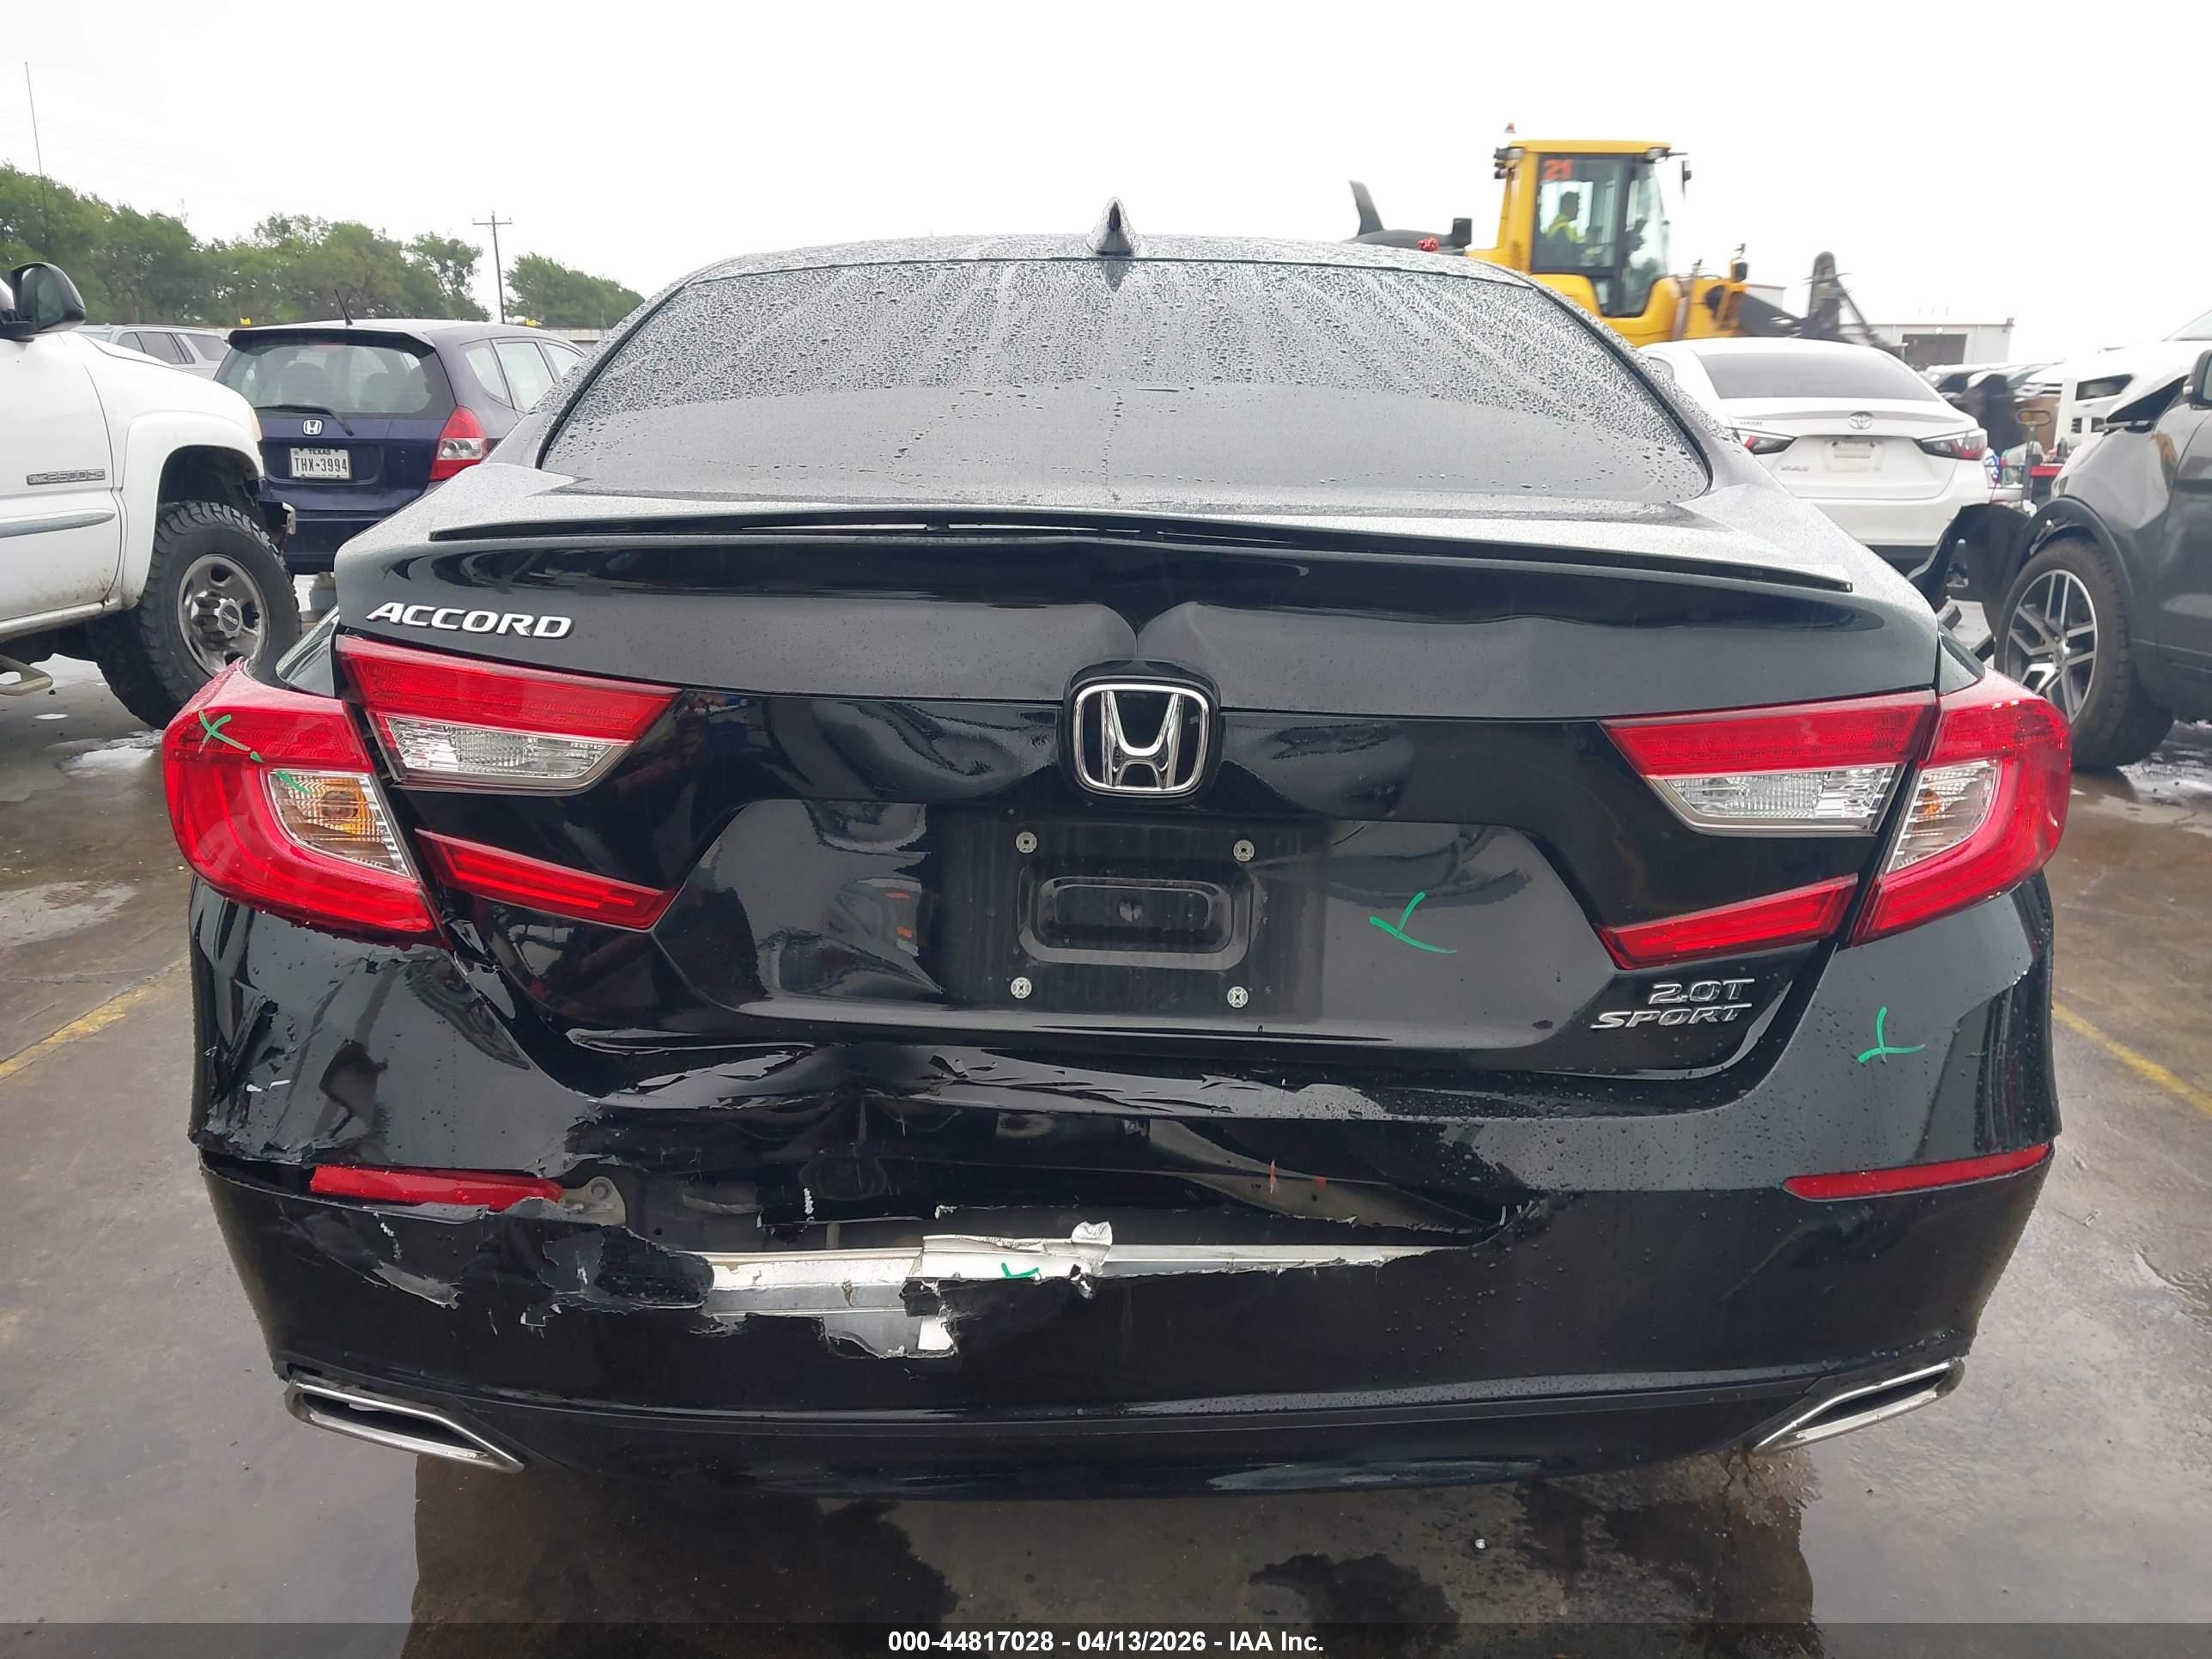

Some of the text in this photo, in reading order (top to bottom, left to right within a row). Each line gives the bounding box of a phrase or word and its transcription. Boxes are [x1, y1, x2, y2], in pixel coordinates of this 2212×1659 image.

[1543, 159, 1572, 179] 21
[366, 601, 573, 639] ACCORD
[1648, 978, 1756, 1005] 2.0T
[1589, 1003, 1753, 1029] SPORT
